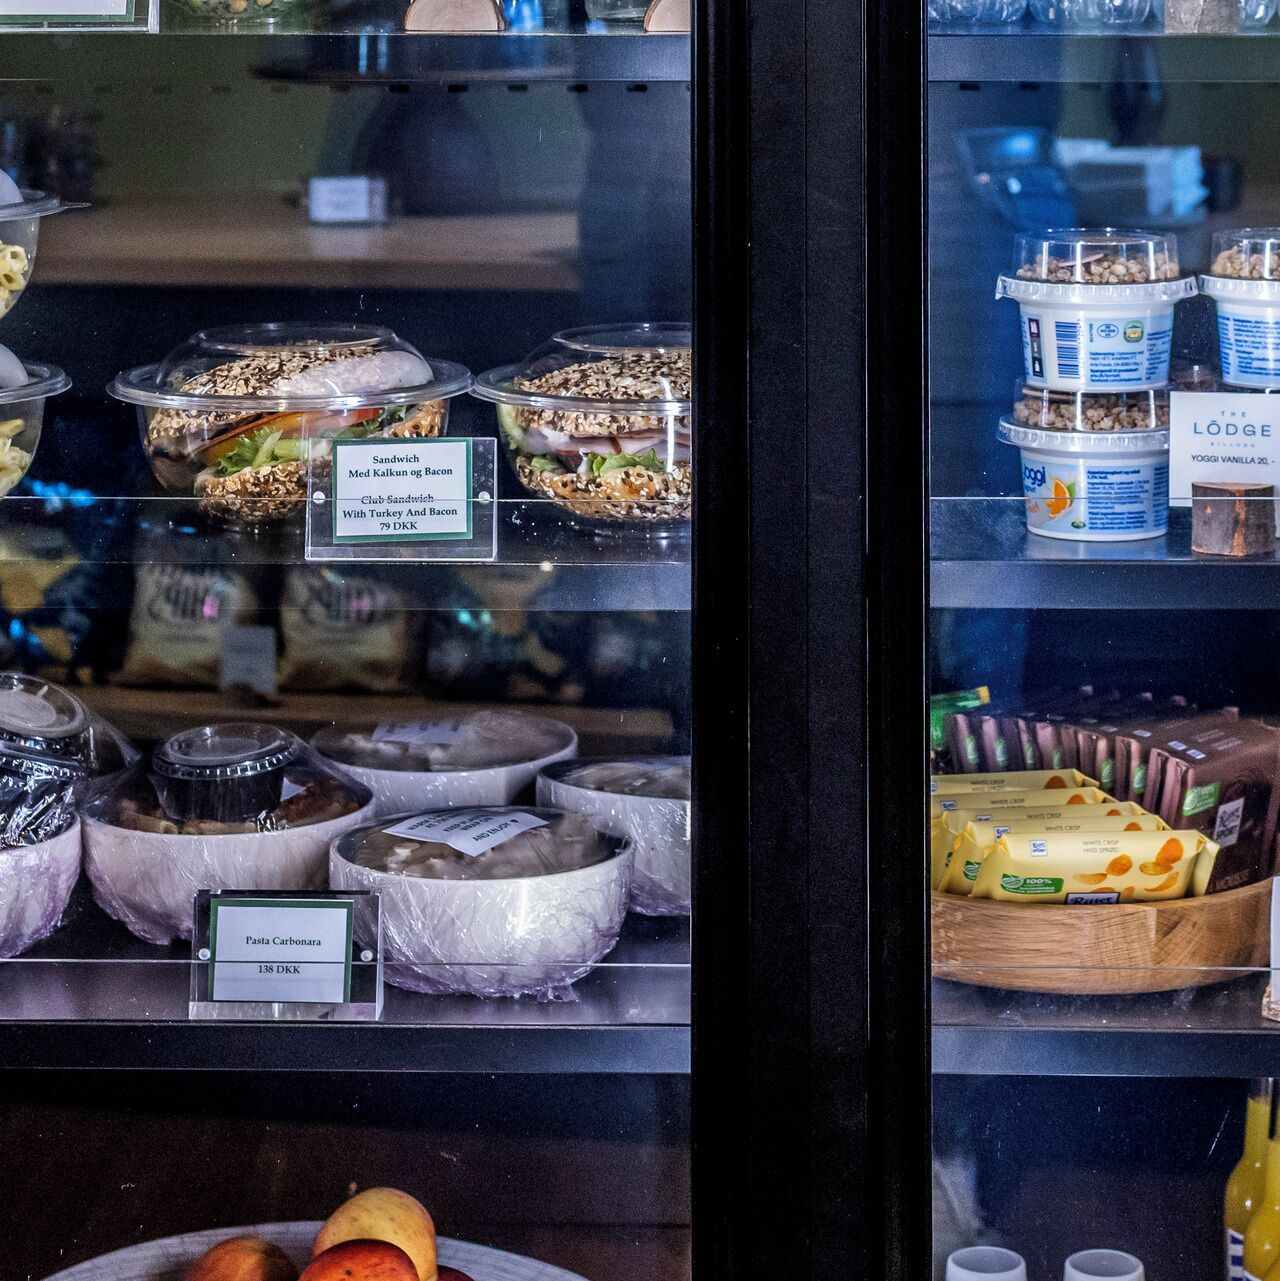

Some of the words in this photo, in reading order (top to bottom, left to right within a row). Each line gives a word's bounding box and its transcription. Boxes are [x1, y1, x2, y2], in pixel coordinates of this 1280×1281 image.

[1194, 420, 1271, 437] LŌDGE
[373, 454, 420, 464] Sandwich
[1191, 454, 1219, 462] YOGGI
[1221, 455, 1256, 464] VANILLA
[348, 469, 370, 478] Med
[373, 469, 408, 477] Kalkun
[410, 470, 423, 479] og
[425, 467, 453, 476] Bacon
[361, 495, 384, 505] Club
[387, 494, 434, 504] Sandwich
[343, 510, 366, 519] With
[369, 509, 403, 520] Turkey
[405, 508, 427, 517] And
[429, 507, 458, 516] Bacon
[380, 522, 391, 531] 79
[393, 521, 418, 531] DKK
[473, 830, 490, 842] AND
[245, 935, 270, 945] Pasta
[272, 936, 321, 946] Carbonara
[258, 965, 273, 974] 138
[276, 965, 301, 974] DKK
